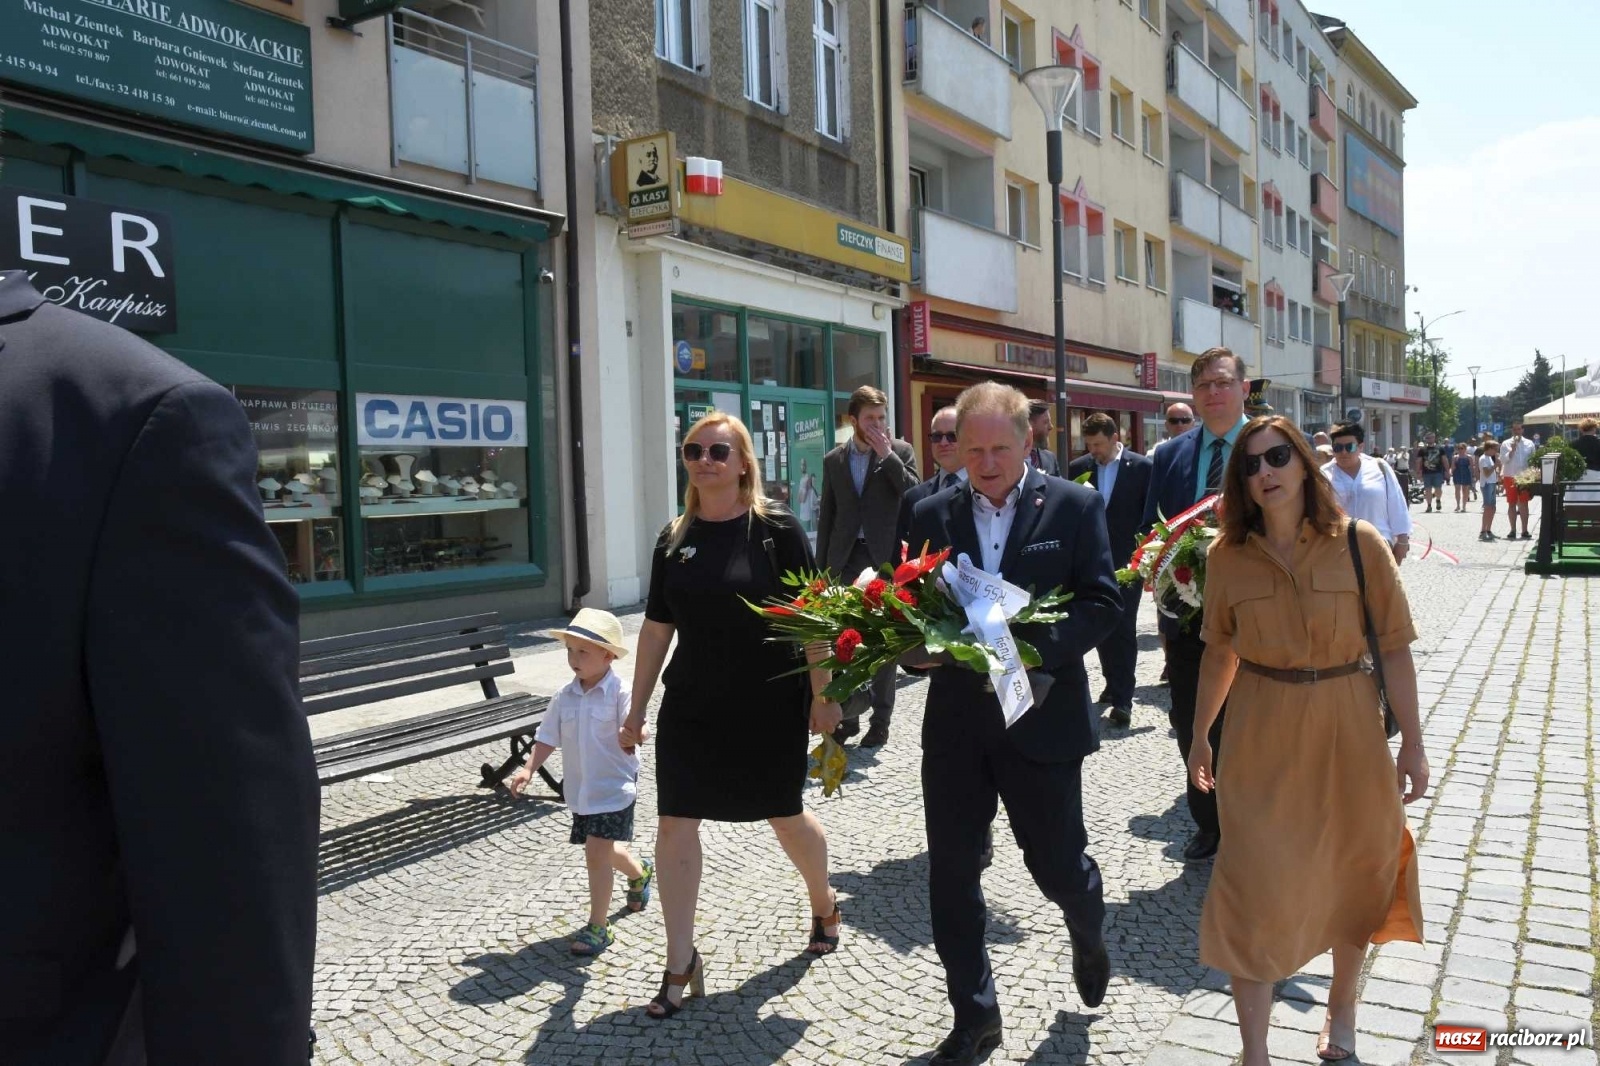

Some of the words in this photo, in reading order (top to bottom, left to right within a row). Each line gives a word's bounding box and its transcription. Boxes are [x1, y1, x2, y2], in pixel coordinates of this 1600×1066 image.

[40, 23, 110, 50] ADWOKAT
[74, 13, 124, 38] Zientek
[60, 43, 75, 54] 602
[132, 30, 180, 54] Barbara
[183, 45, 228, 69] Gniewek
[177, 12, 304, 65] ADWOKACKIE
[6, 55, 26, 69] 415
[28, 60, 42, 73] 94
[45, 65, 58, 77] 94
[154, 54, 211, 79] ADWOKAT
[232, 60, 265, 80] Stefan
[267, 70, 304, 90] Zientek
[117, 83, 130, 95] 32
[131, 87, 149, 100] 418
[152, 92, 163, 103] 15
[164, 96, 176, 107] 30
[243, 81, 295, 102] ADWOKAT
[187, 103, 218, 117] e-mail:
[642, 190, 667, 203] KASY
[840, 228, 874, 250] STEFCZYK
[876, 239, 904, 260] FINANSE
[43, 276, 167, 323] Karpisz
[240, 398, 288, 409] NAPRAWA
[248, 421, 280, 432] ERWIS
[363, 398, 513, 441] CASIO
[794, 417, 820, 434] GRAMY
